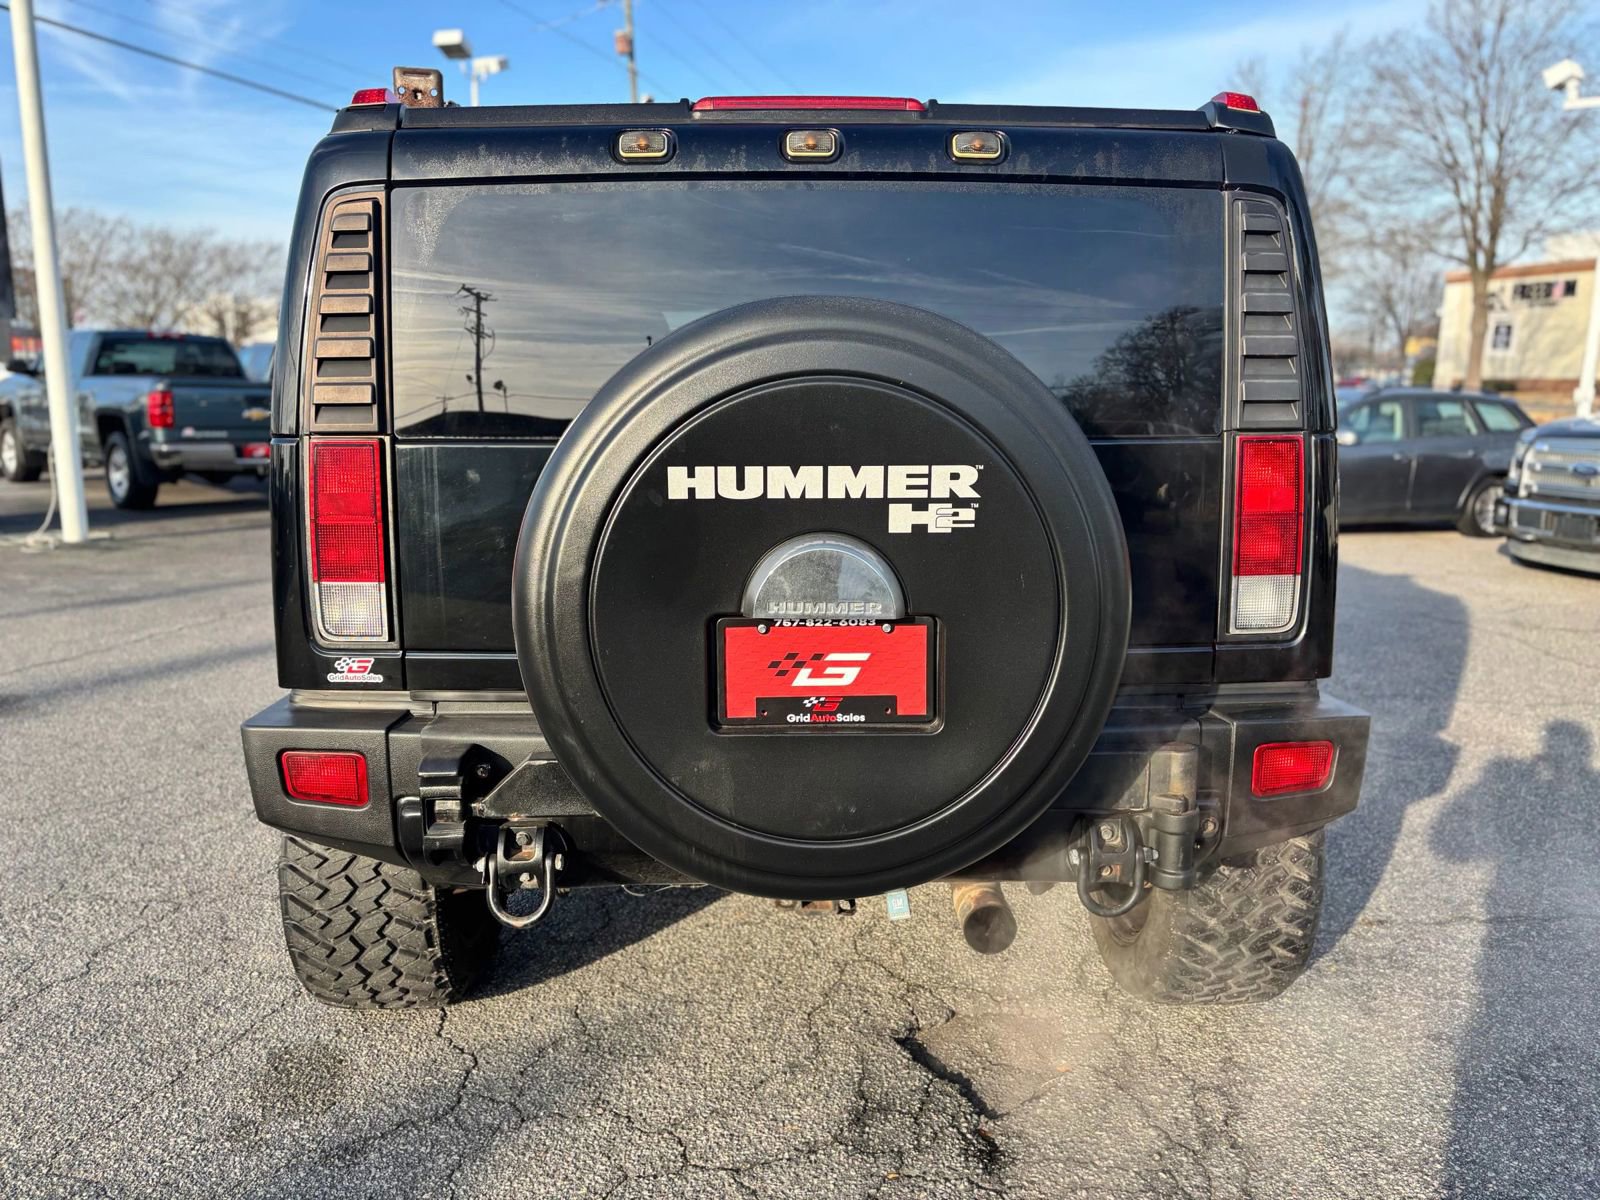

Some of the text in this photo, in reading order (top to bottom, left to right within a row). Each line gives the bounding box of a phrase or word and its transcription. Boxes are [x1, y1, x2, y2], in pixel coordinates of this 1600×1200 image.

[667, 465, 981, 500] HUMMER
[888, 503, 976, 533] H2
[766, 601, 882, 614] HUMMER
[786, 713, 866, 723] GridAutoSales
